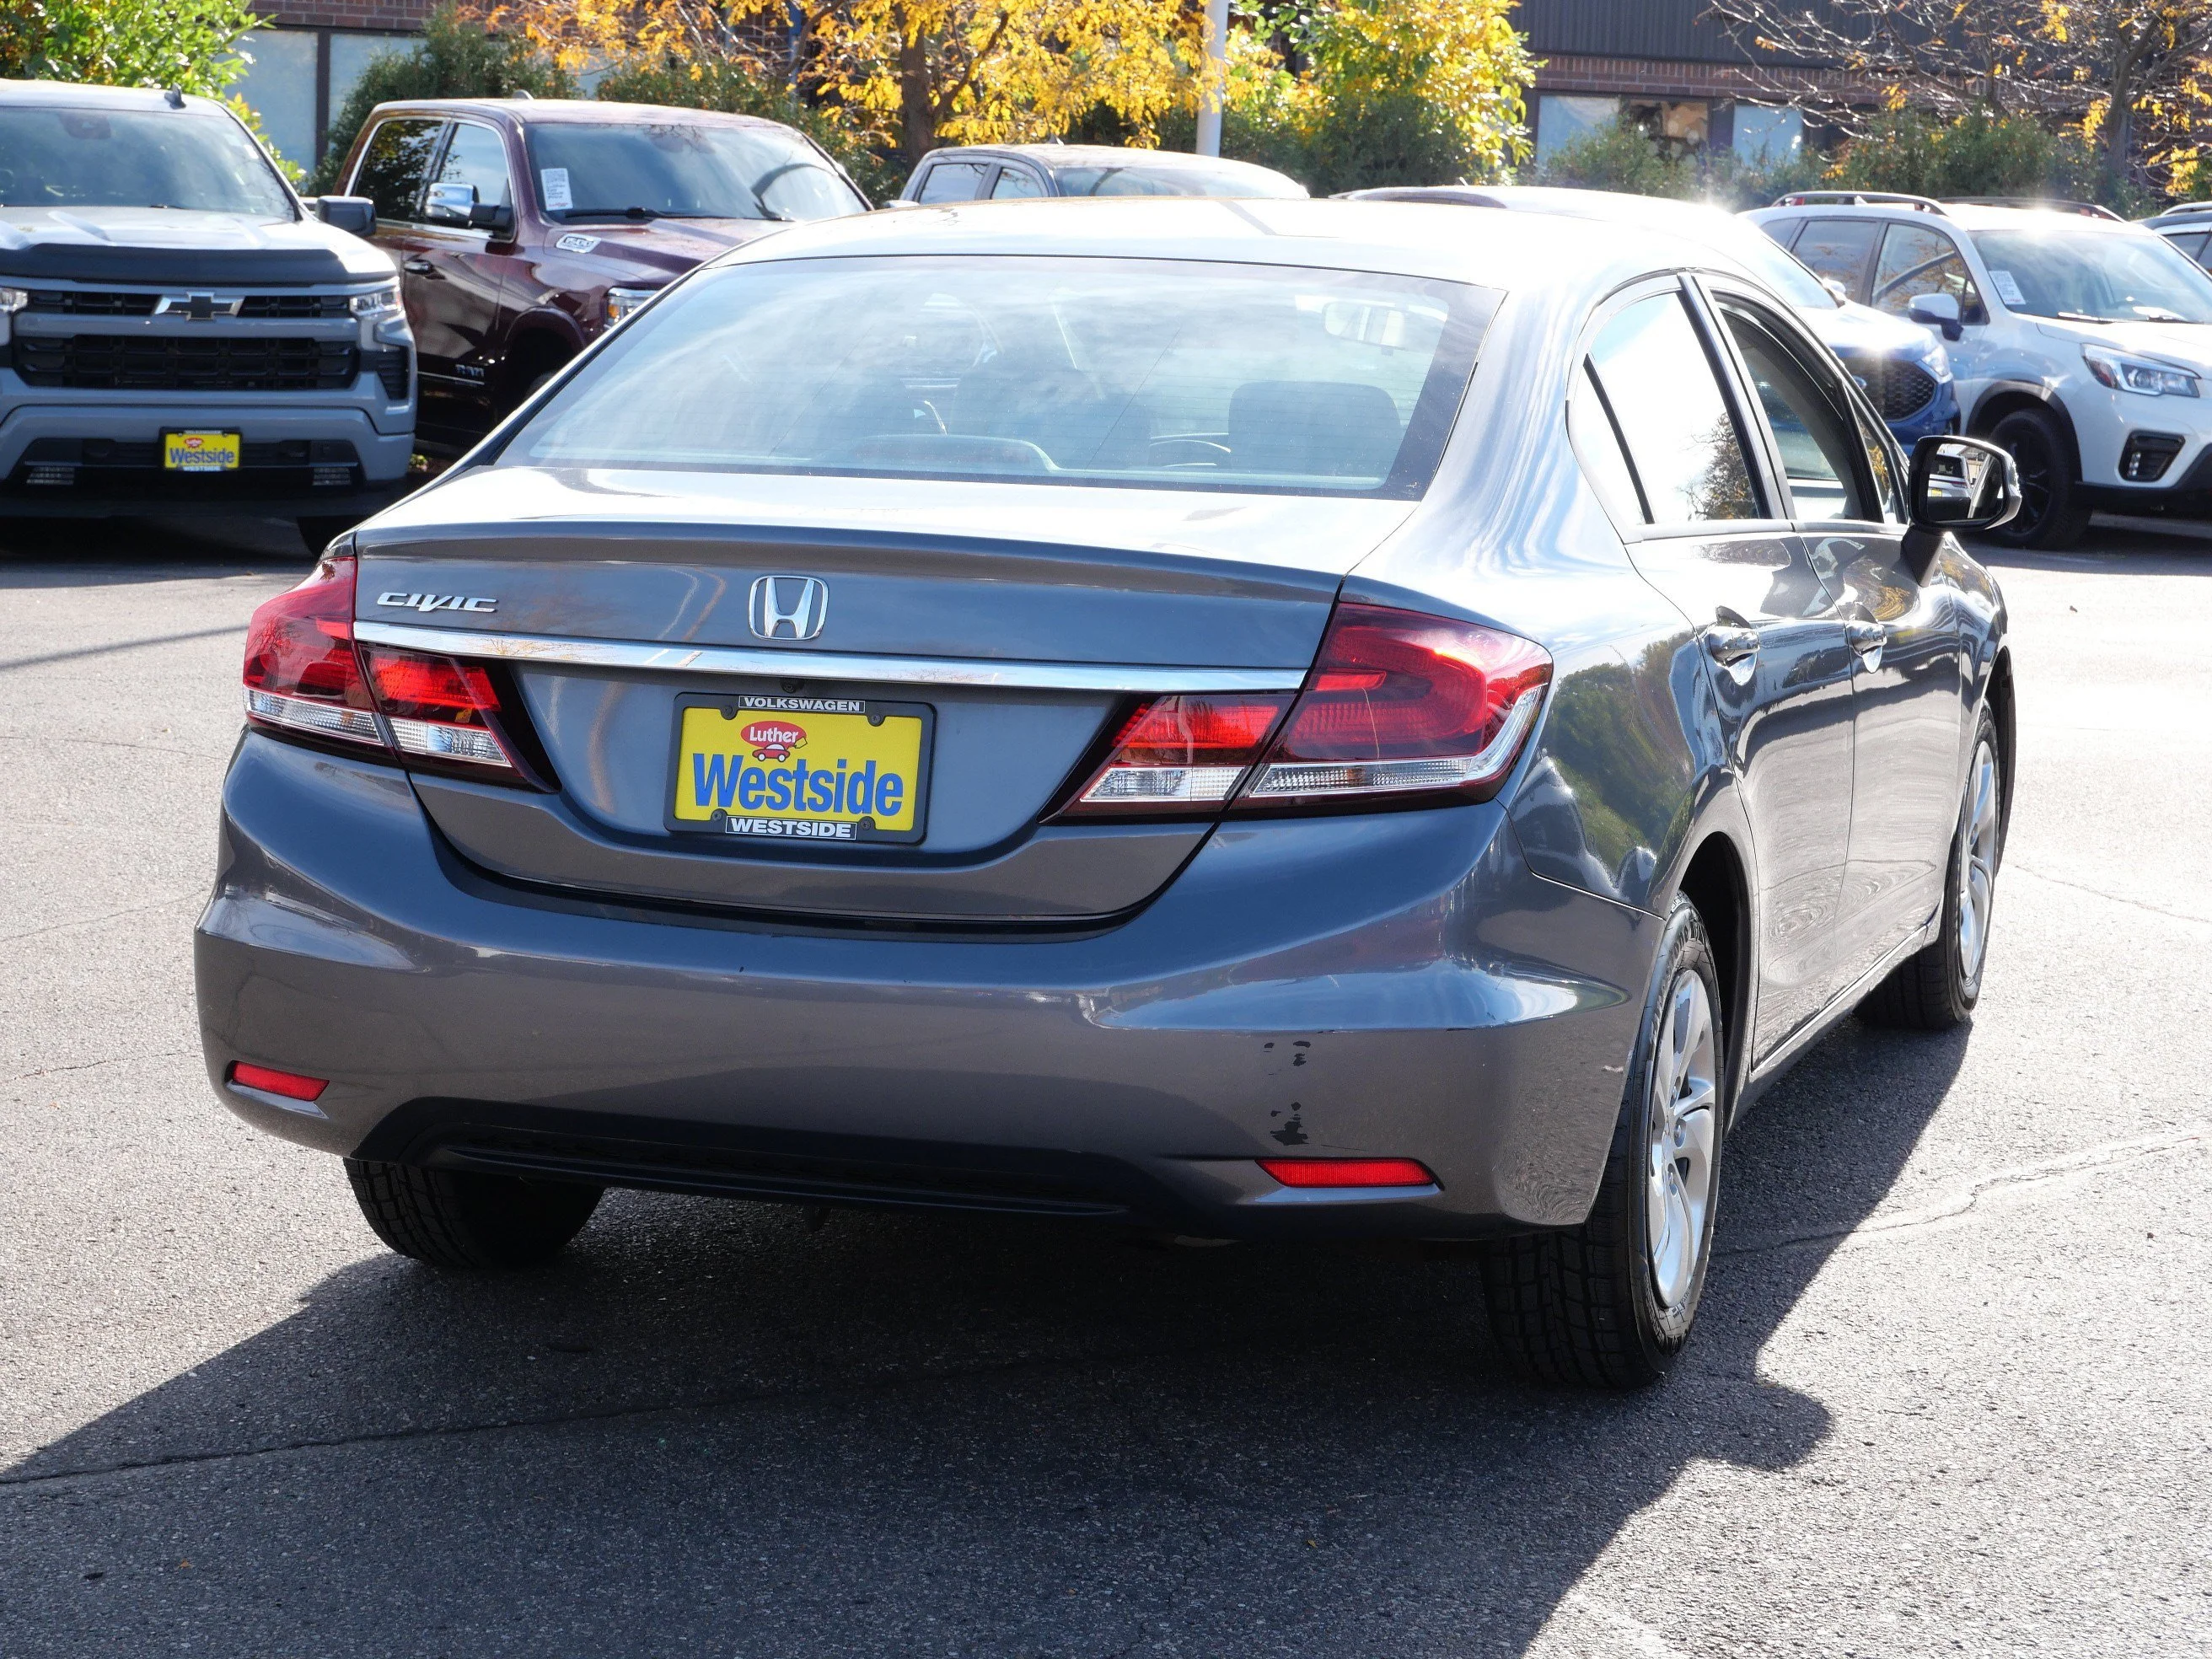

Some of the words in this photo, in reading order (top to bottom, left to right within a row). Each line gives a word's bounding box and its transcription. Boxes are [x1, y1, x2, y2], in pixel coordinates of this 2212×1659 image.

[170, 448, 234, 463] Westside
[377, 592, 498, 613] CIVIC
[744, 697, 861, 712] VOLKSWAGEN
[749, 726, 799, 744] Luther
[692, 753, 904, 816] Westside
[732, 819, 851, 838] WESTSIDE
